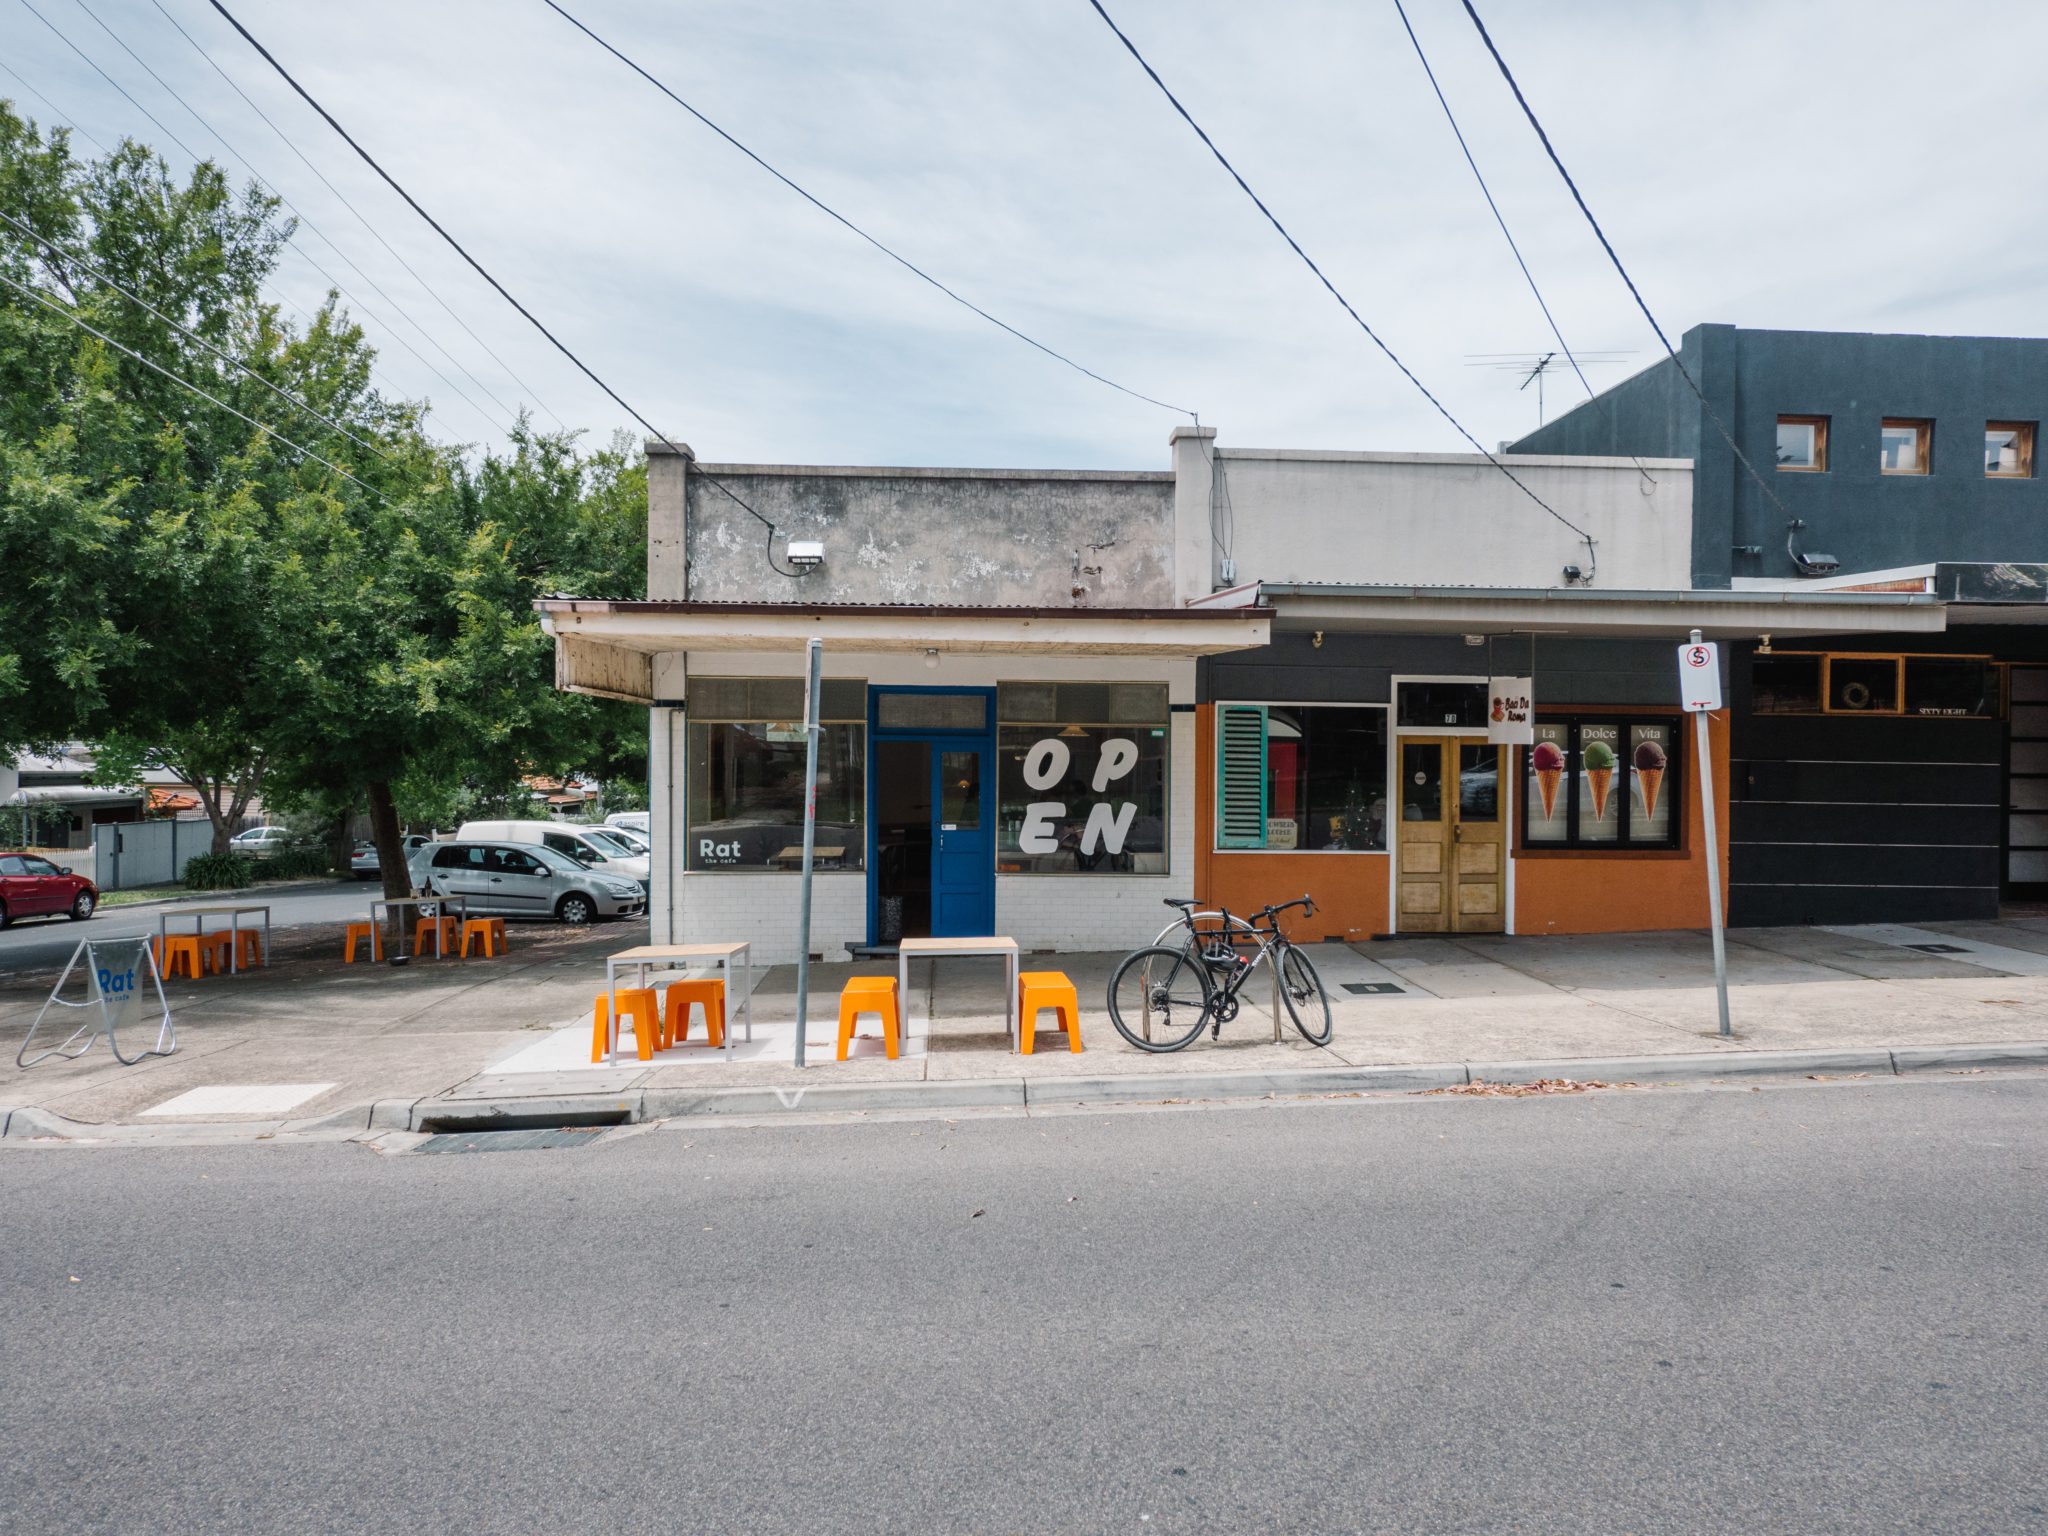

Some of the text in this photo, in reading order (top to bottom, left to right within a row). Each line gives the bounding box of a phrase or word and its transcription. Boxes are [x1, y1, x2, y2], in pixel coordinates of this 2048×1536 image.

[1508, 711, 1526, 723] Roma
[1919, 708, 1941, 716] SIXTY
[1542, 728, 1661, 740] La Dolce Vita
[700, 839, 741, 857] Rat
[98, 968, 134, 993] Rat
